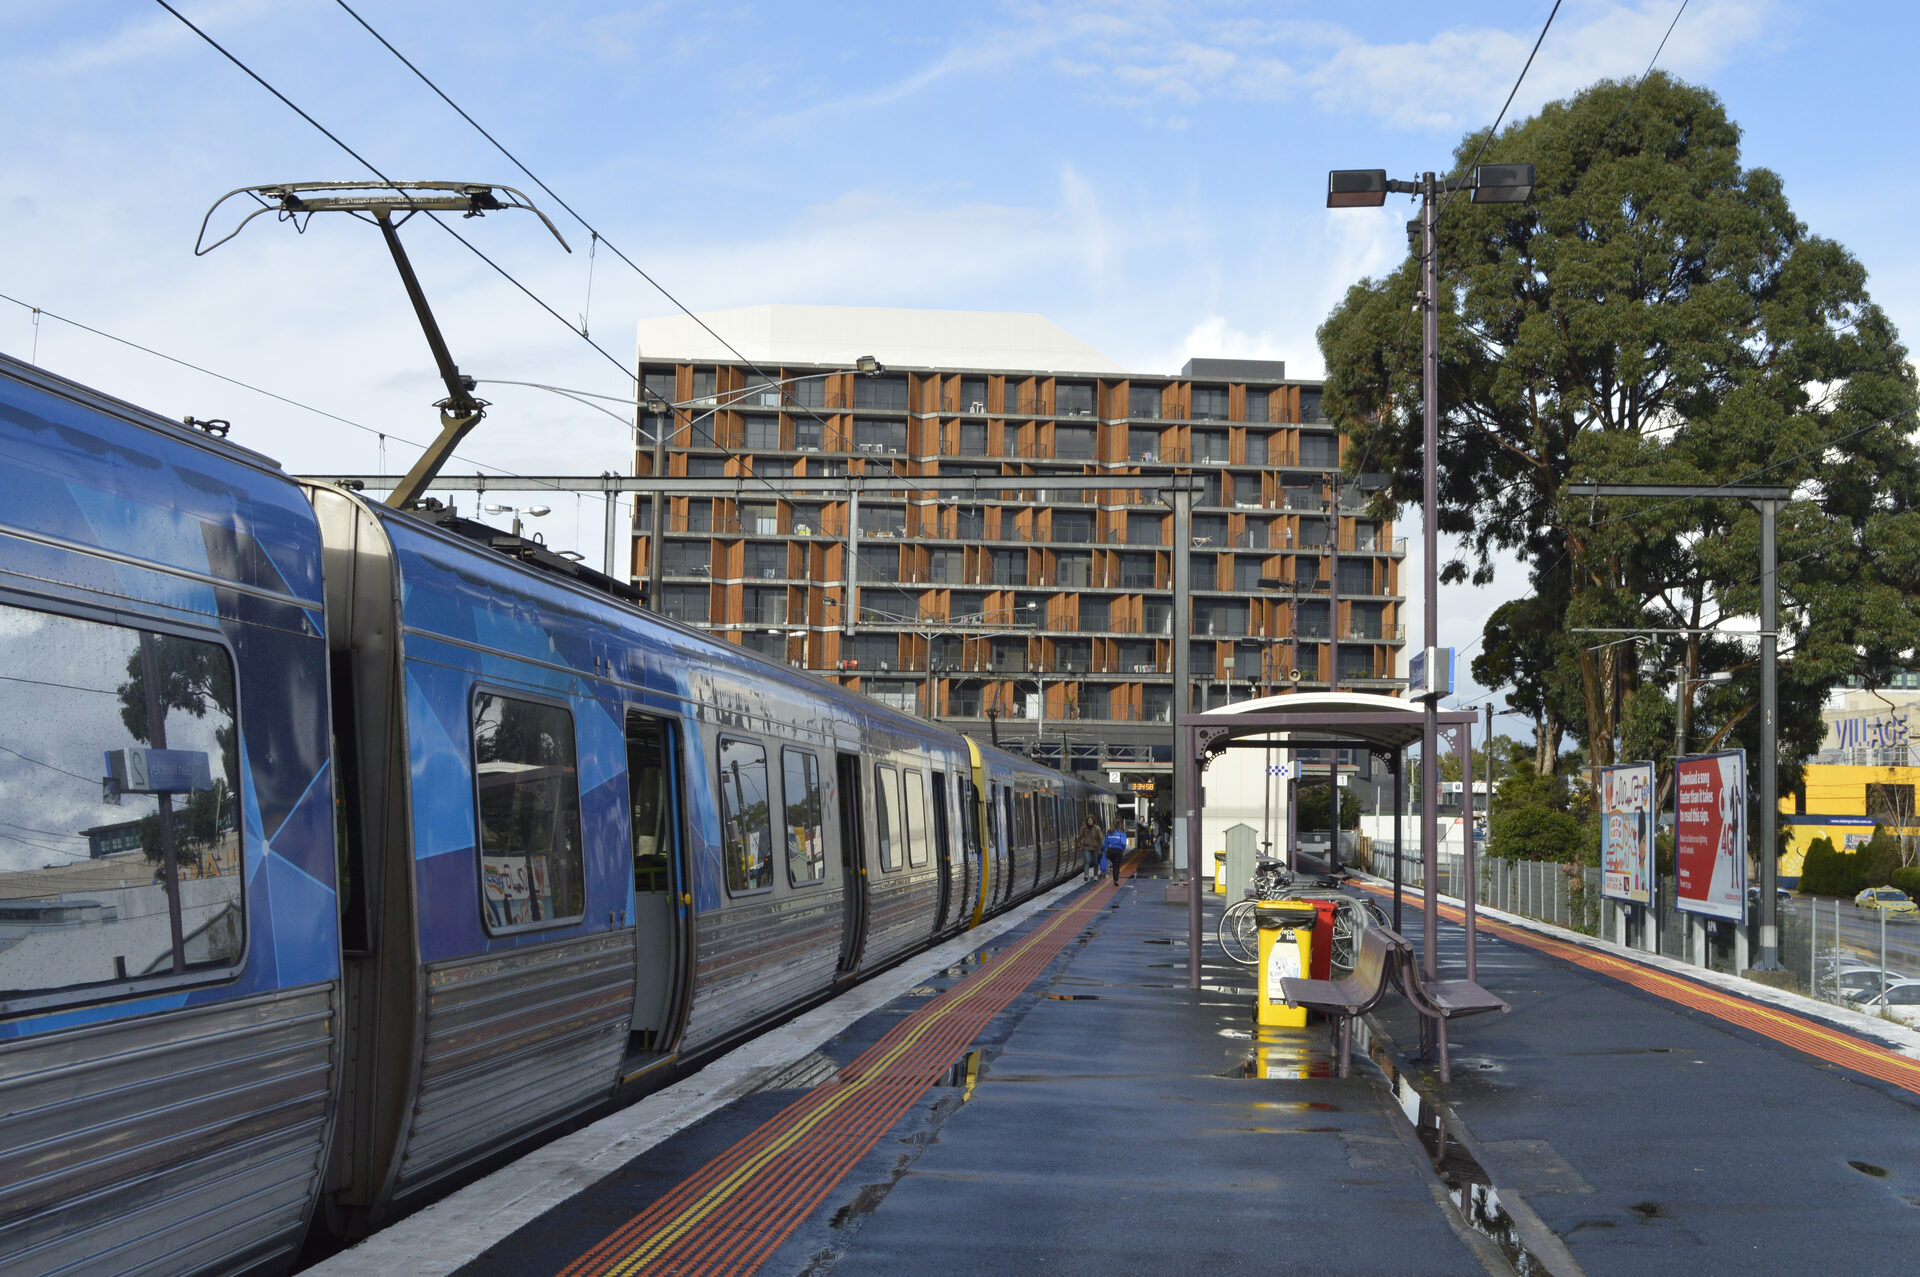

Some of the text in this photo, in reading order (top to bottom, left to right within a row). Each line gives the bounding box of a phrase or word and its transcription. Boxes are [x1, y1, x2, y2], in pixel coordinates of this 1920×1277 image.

[1836, 714, 1909, 749] VILLAGE
[1111, 772, 1119, 782] 2
[1680, 770, 1697, 785] Download
[1721, 823, 1733, 856] 4G
[1707, 920, 1717, 932] APN
